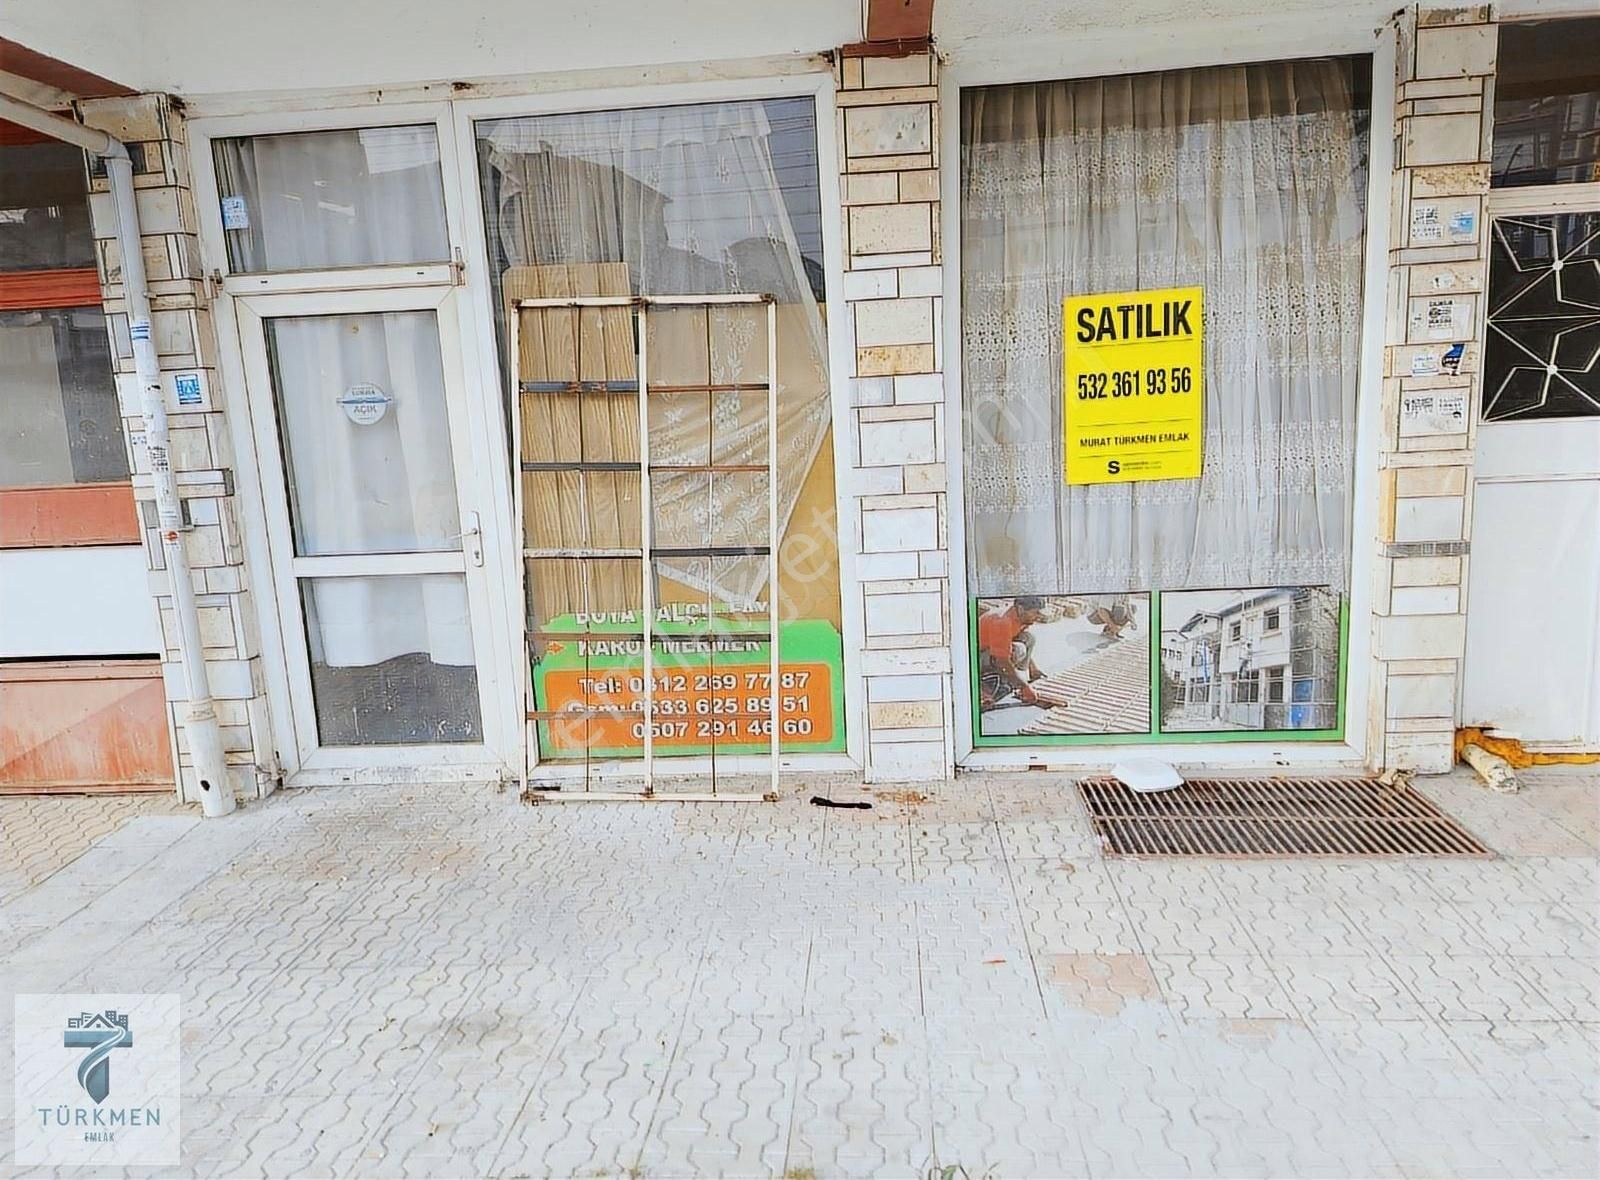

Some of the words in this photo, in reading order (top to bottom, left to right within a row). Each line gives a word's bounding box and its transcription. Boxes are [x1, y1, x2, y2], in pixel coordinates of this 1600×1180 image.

[1076, 300, 1193, 343] SATILIK
[1078, 373, 1108, 400] 532
[1112, 370, 1140, 397] 361
[1146, 368, 1167, 395] 93
[1171, 366, 1192, 393] 56
[1080, 437, 1111, 448] MURAT
[1114, 434, 1157, 446] TÜRKMEN
[1158, 432, 1190, 443] EMLAK
[578, 676, 622, 694] Tel:
[694, 673, 737, 691] 269
[744, 672, 772, 690] 77
[781, 671, 810, 689] 87
[695, 697, 738, 715] 625
[746, 697, 772, 713] 89
[783, 695, 809, 712] 51
[697, 719, 738, 737] 291
[747, 719, 773, 736] 46
[783, 718, 812, 735] 60
